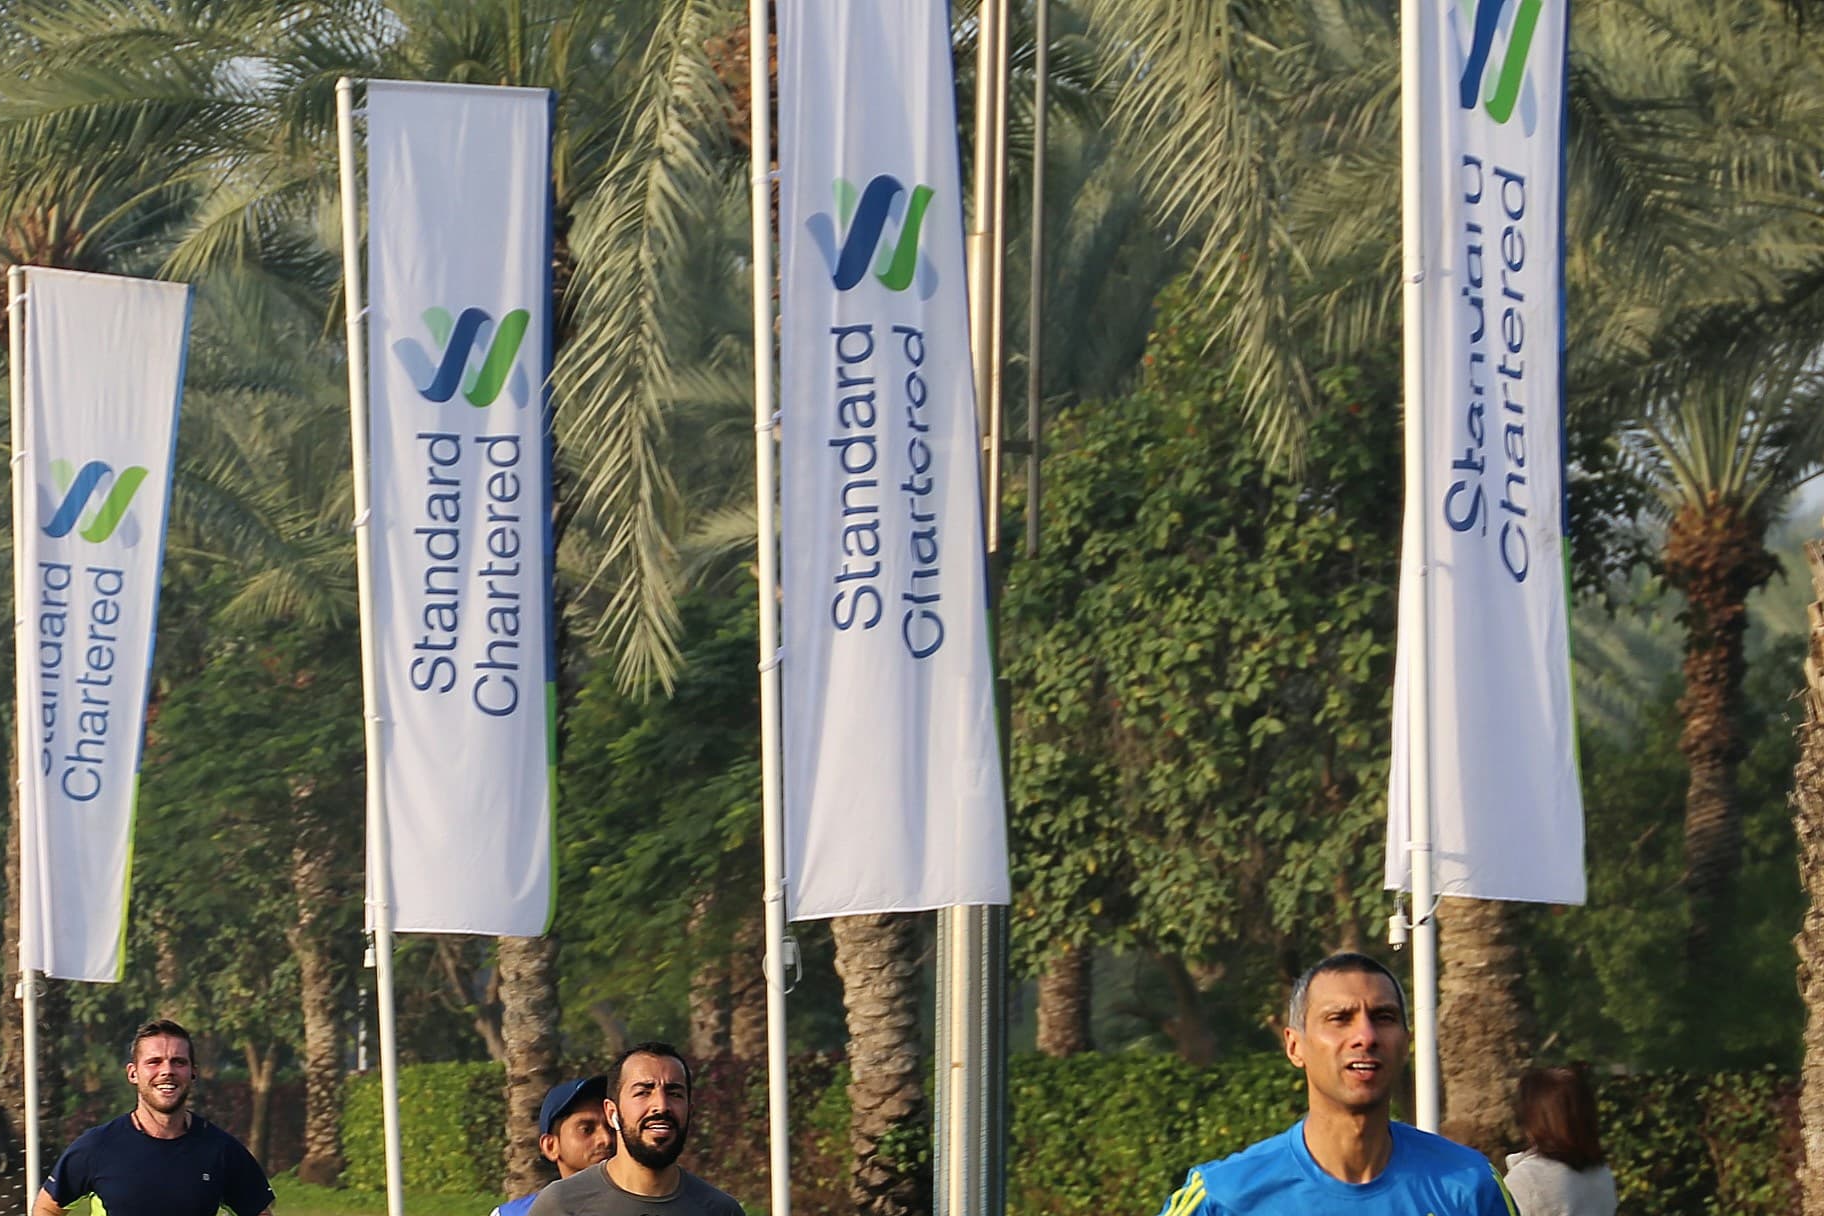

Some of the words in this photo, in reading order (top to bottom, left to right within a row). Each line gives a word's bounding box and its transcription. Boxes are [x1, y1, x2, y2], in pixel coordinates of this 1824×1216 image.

[828, 324, 883, 631] Standard
[891, 325, 945, 660] Chartered
[1494, 166, 1529, 583] Chartered
[60, 566, 125, 803] Chartered
[409, 432, 462, 694] Standard
[472, 434, 521, 718] Chartered
